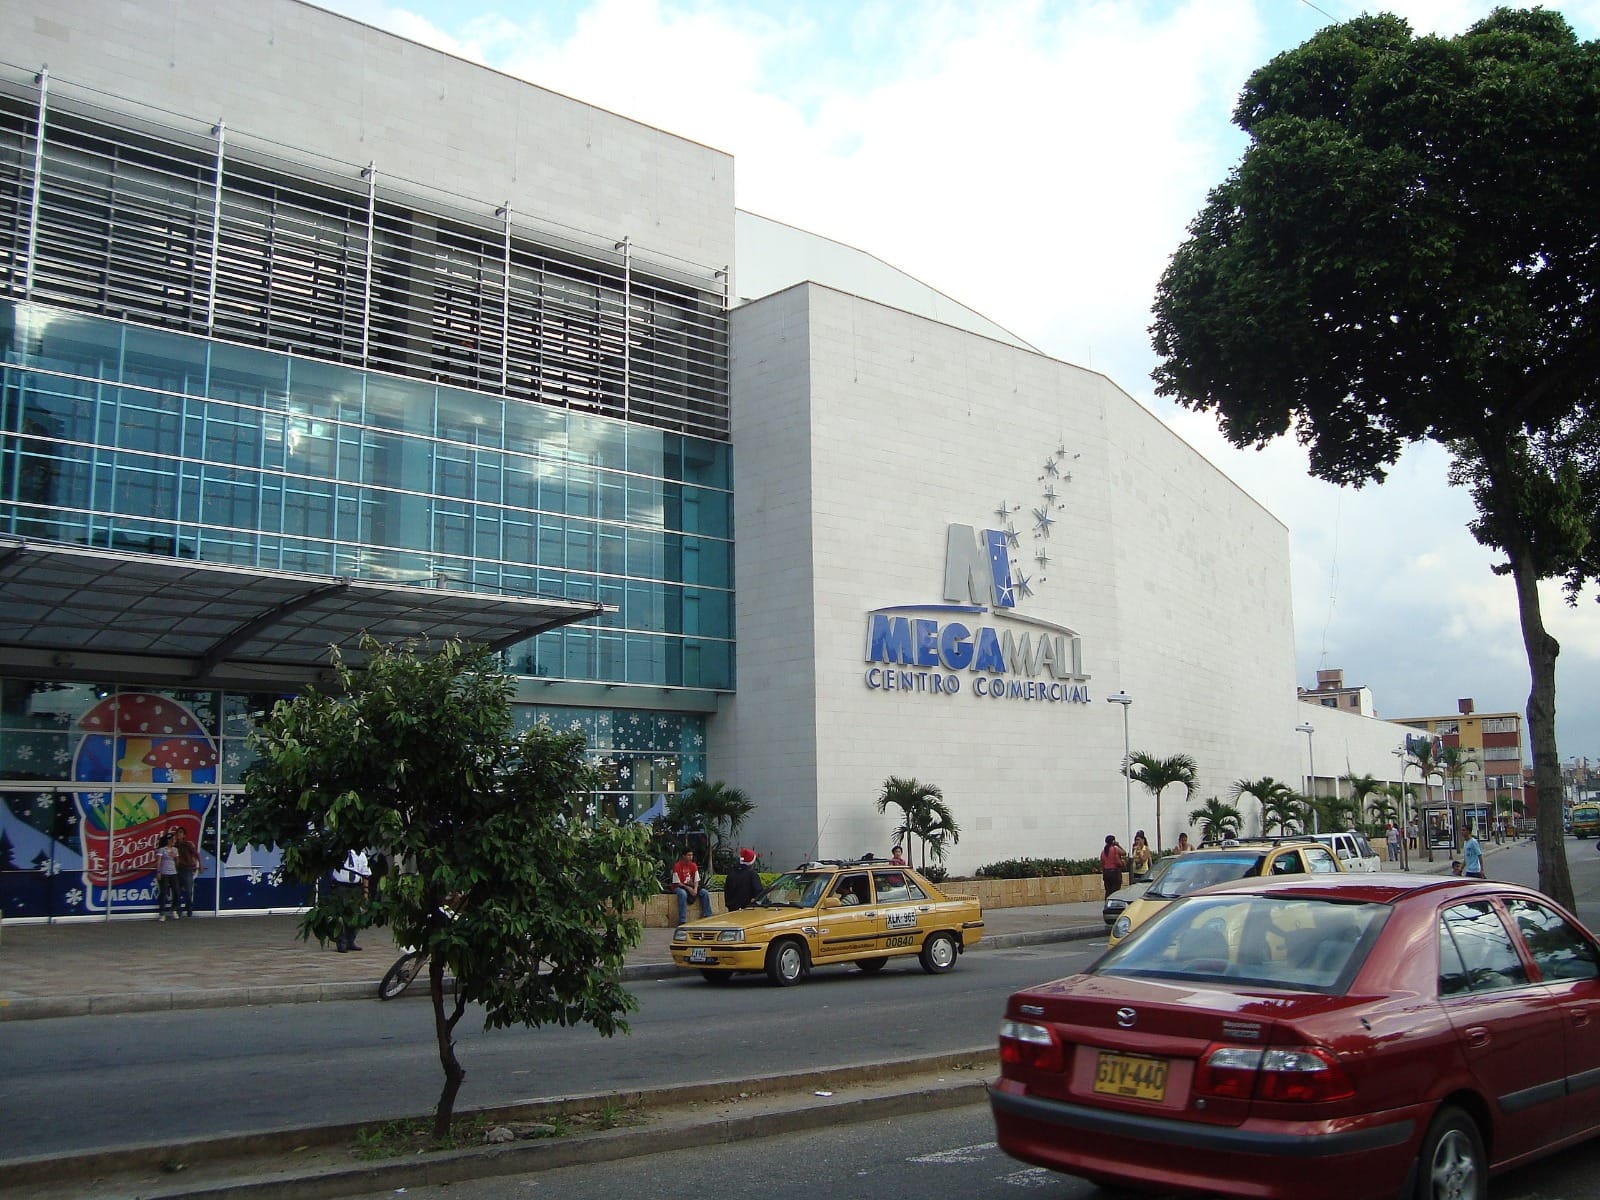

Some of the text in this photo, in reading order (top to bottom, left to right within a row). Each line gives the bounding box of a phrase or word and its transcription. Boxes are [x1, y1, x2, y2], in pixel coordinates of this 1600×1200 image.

[864, 614, 1092, 680] MEGAMALL
[865, 668, 1091, 703] CENTRO COMERCIAL
